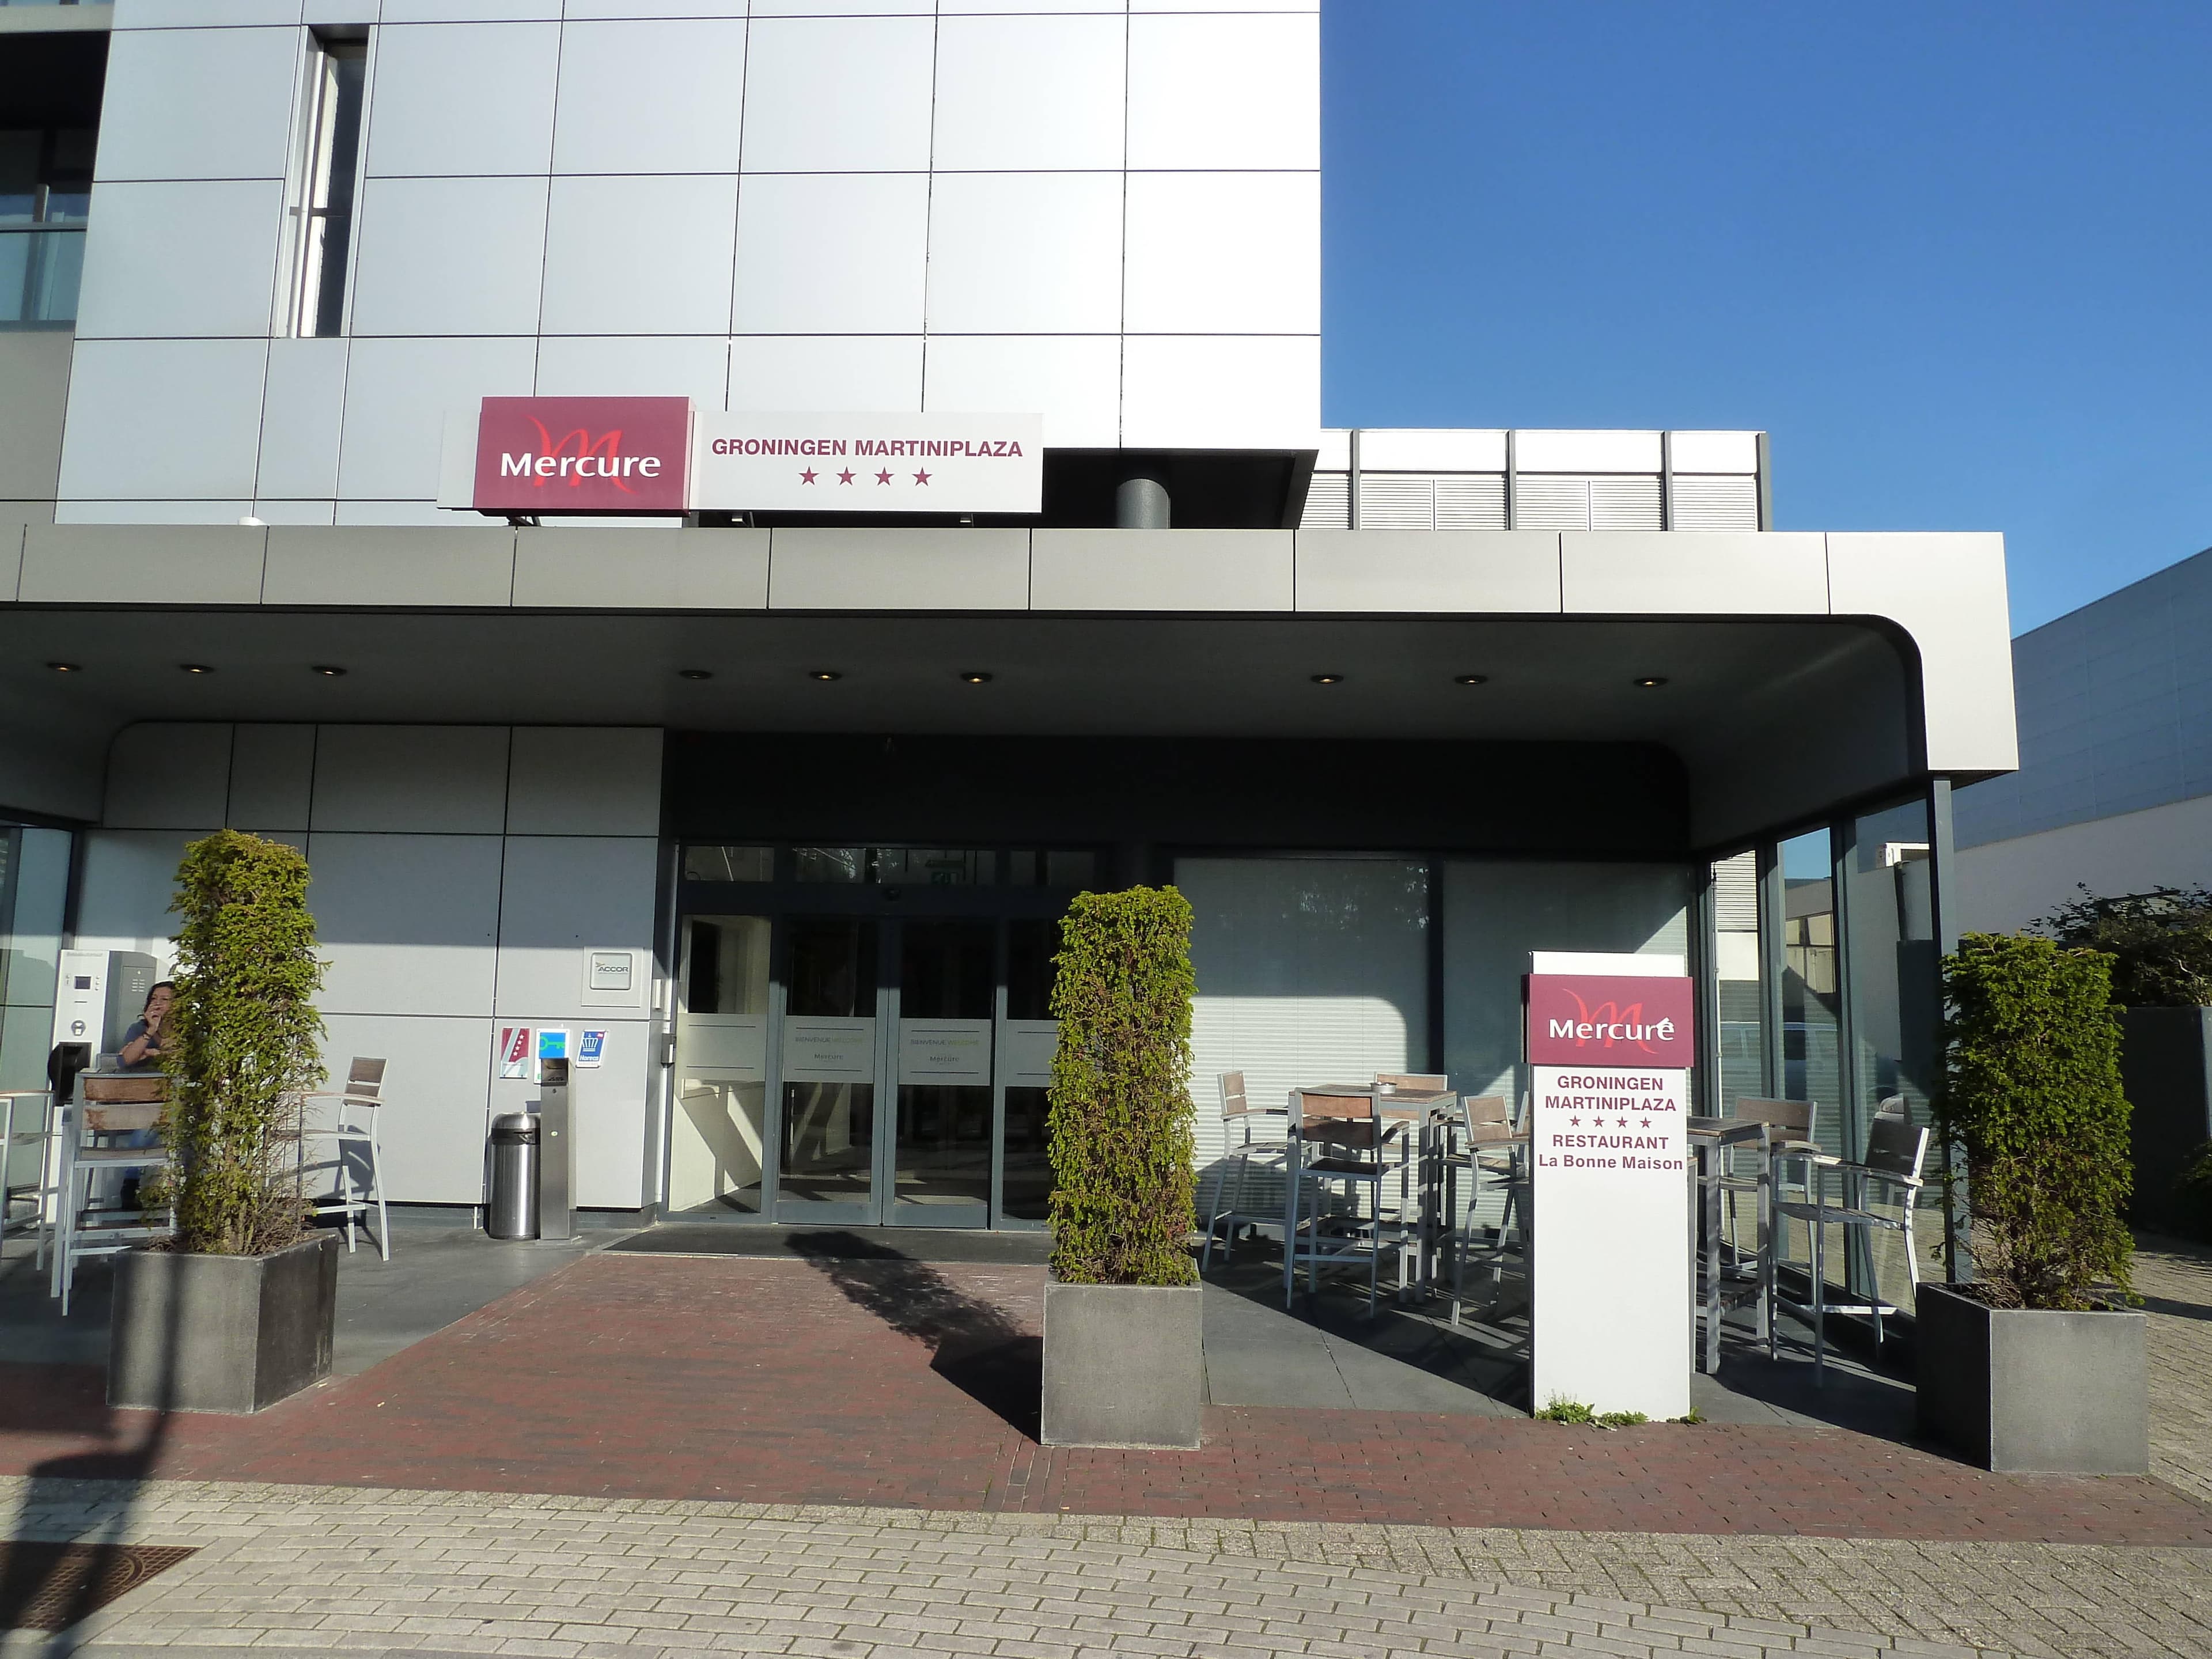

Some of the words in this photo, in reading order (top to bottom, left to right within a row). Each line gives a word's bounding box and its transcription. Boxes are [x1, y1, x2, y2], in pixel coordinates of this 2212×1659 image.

[711, 438, 847, 456] GRONINGEN
[854, 440, 1024, 459] MARTINIPLAZA
[500, 452, 661, 478] Mercure
[1557, 1075, 1664, 1091] GRONINGEN
[1545, 1096, 1677, 1112] MARTINIPLAZA
[1552, 1134, 1669, 1150] RESTAURANT
[1539, 1154, 1558, 1167] La
[1563, 1154, 1617, 1168] Bonne
[1622, 1156, 1683, 1170] Maison
